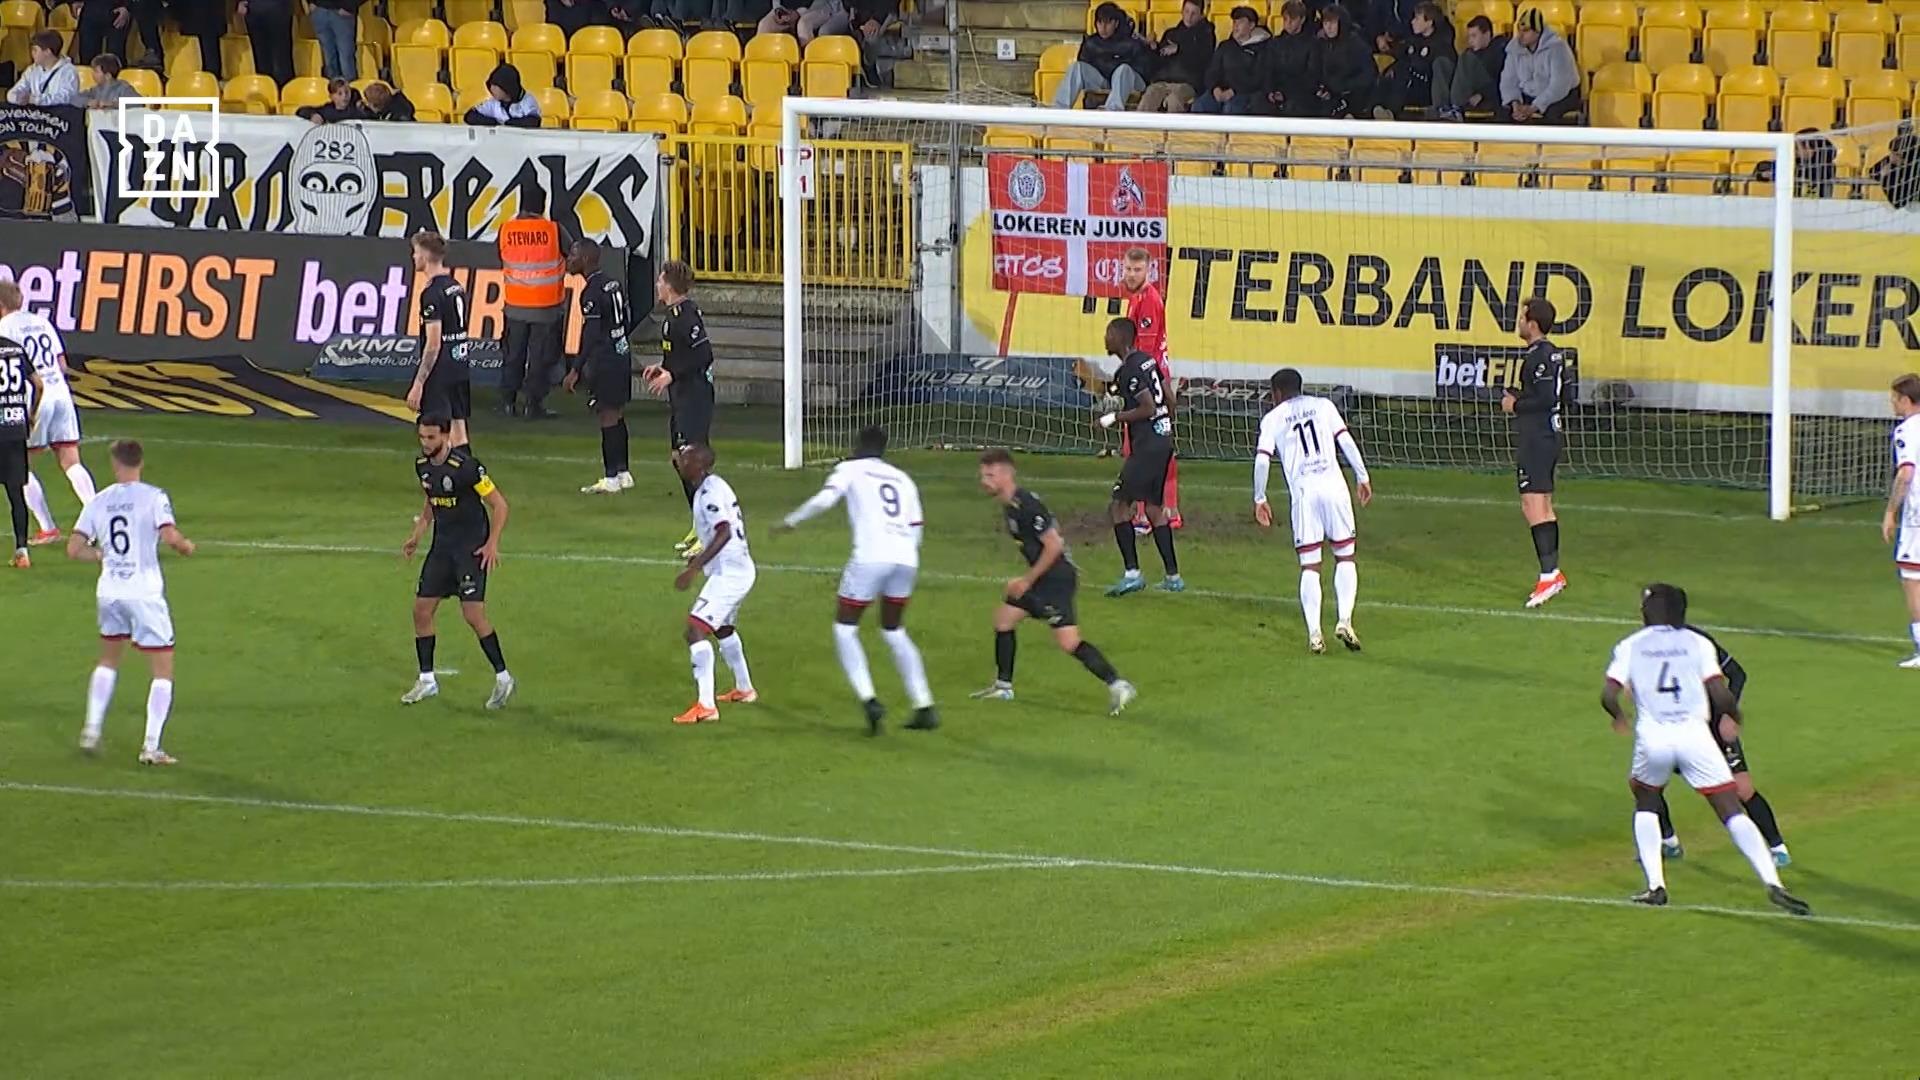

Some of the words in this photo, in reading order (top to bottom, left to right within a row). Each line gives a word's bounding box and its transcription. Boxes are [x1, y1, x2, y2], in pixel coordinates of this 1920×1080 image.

[314, 140, 355, 161] 282
[507, 231, 549, 246] STEWARD
[993, 212, 1086, 236] LOKEREN
[1093, 220, 1162, 239] JUNGS
[0, 251, 276, 340] etFIRST
[24, 333, 54, 370] 28
[338, 338, 418, 352] MMC
[0, 356, 22, 392] 35
[1151, 368, 1164, 404] 3
[1293, 418, 1321, 457] 11
[879, 483, 901, 518] 9
[110, 515, 130, 555] 6
[1656, 661, 1682, 703] 4
